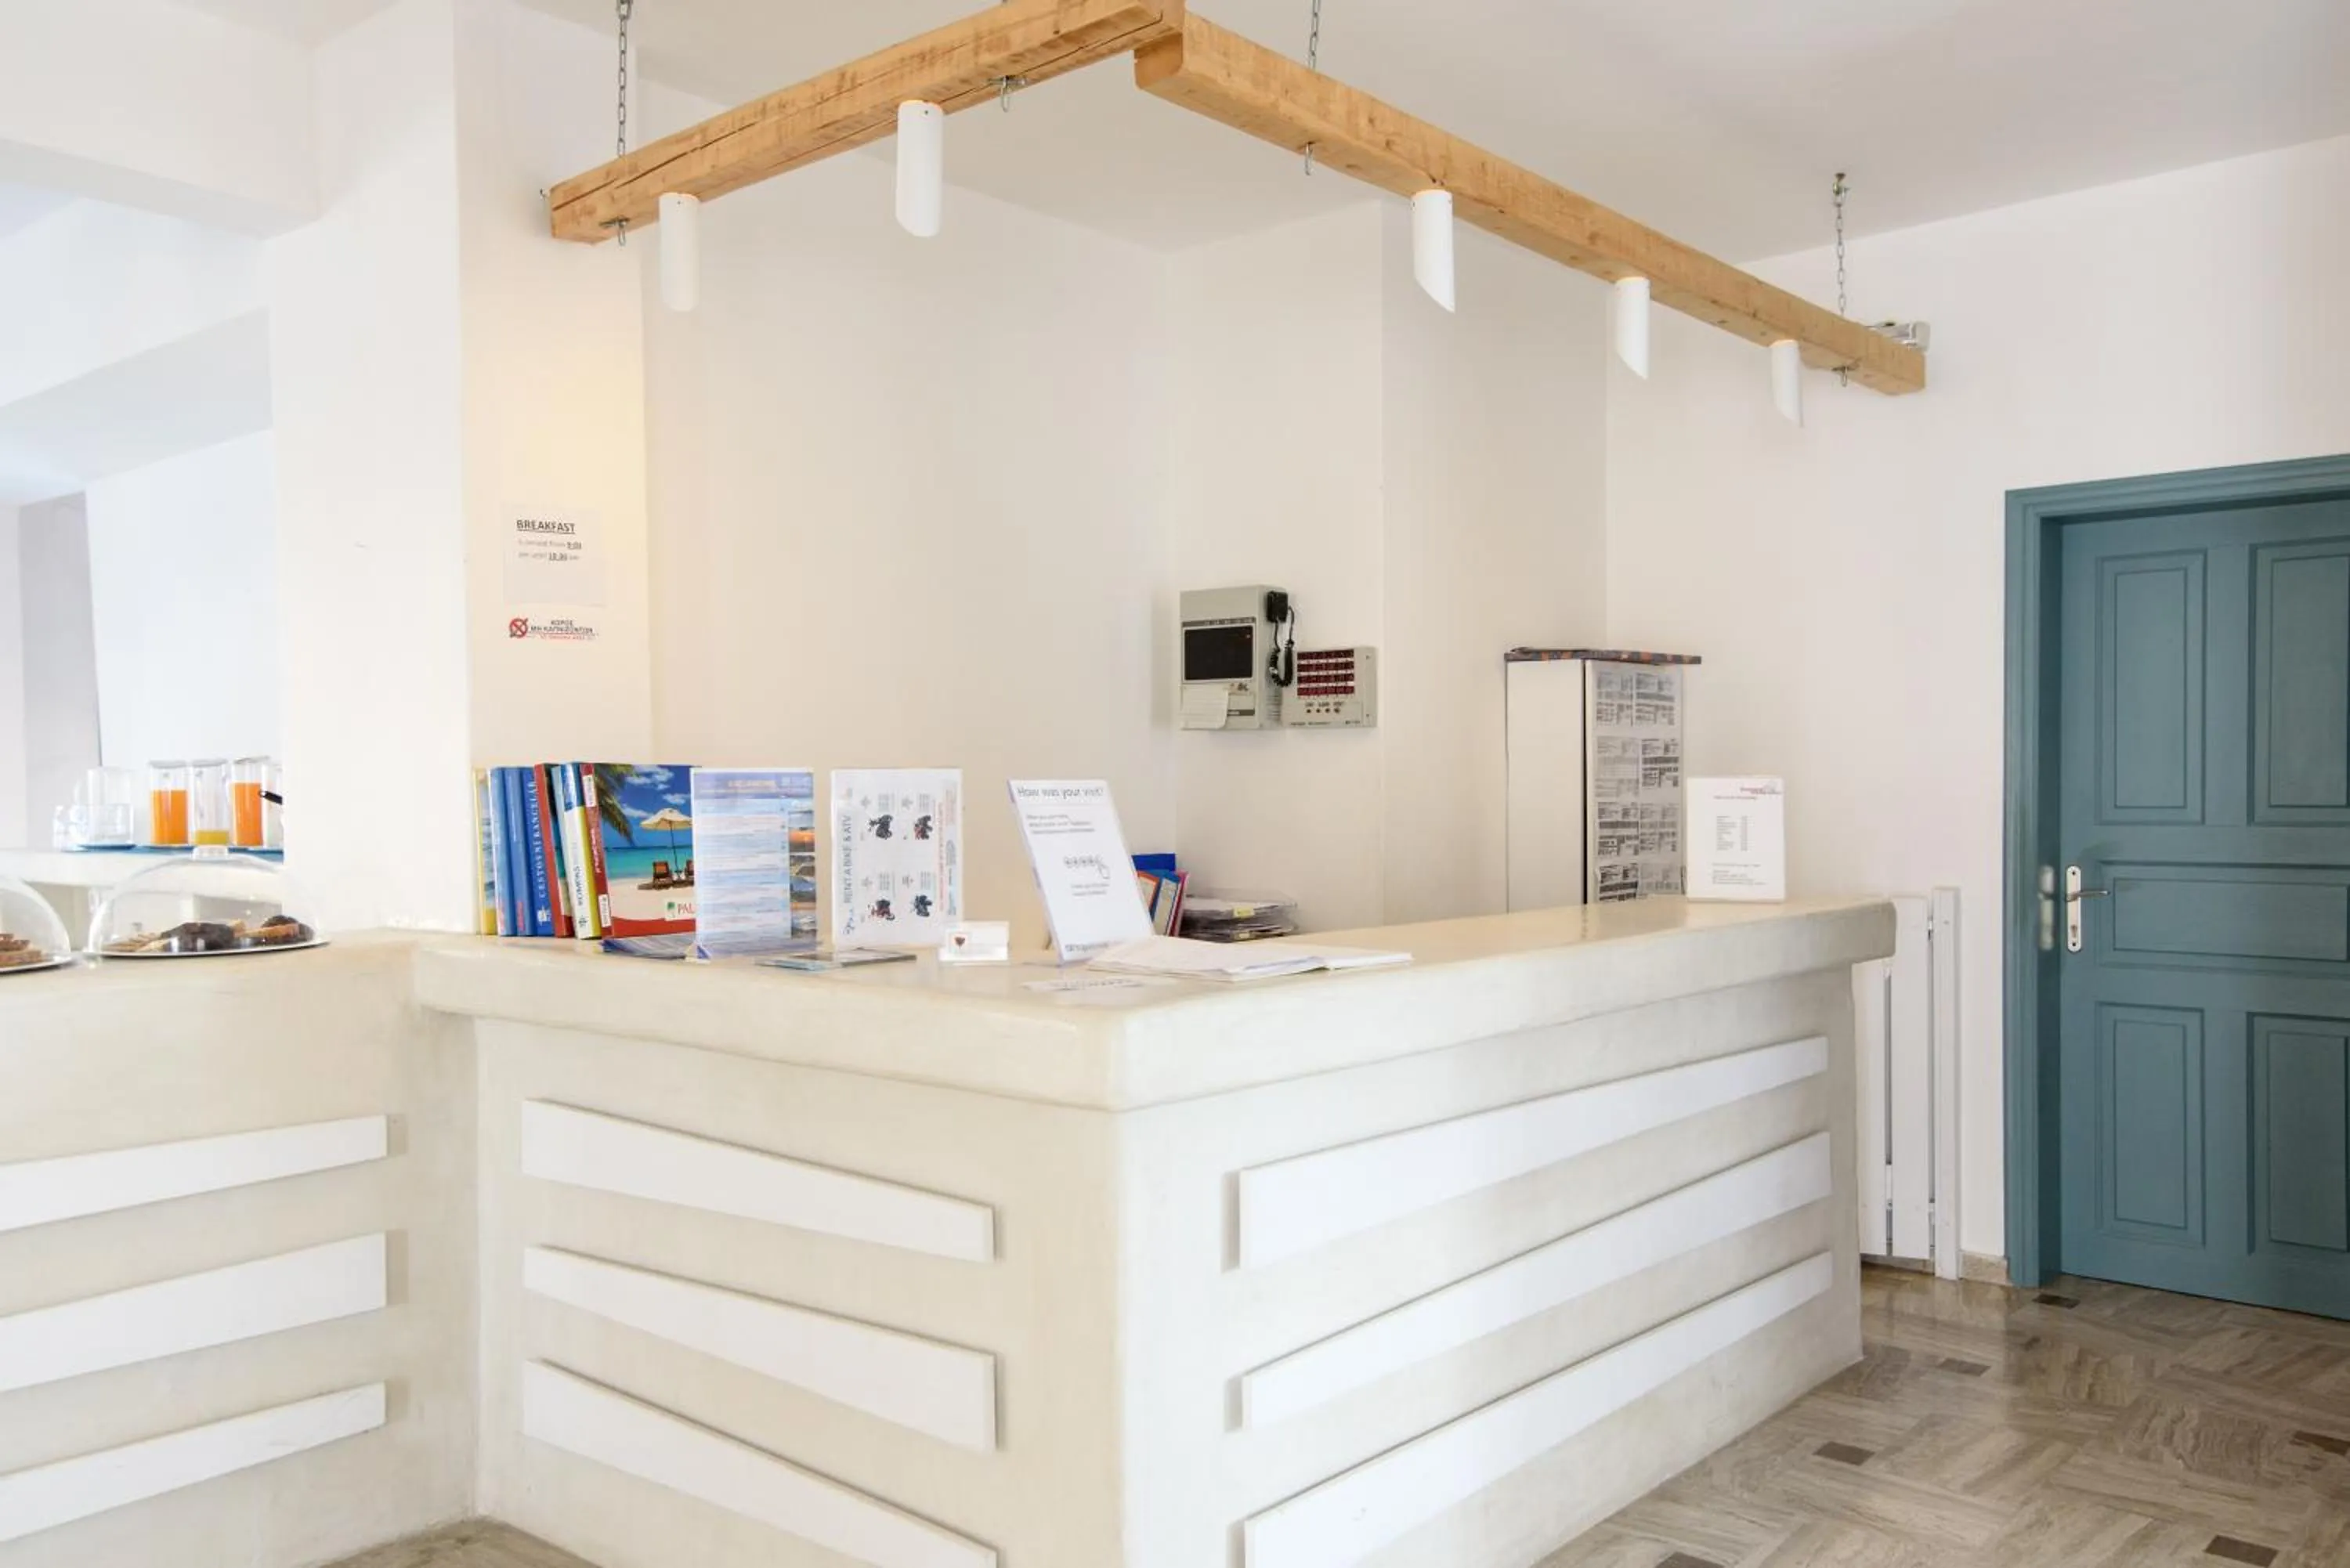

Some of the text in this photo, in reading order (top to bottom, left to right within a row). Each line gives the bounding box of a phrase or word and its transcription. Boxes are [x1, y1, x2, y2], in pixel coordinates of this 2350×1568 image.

[516, 519, 575, 534] BREAKFAST
[1018, 786, 1039, 797] How
[1061, 789, 1080, 800] your
